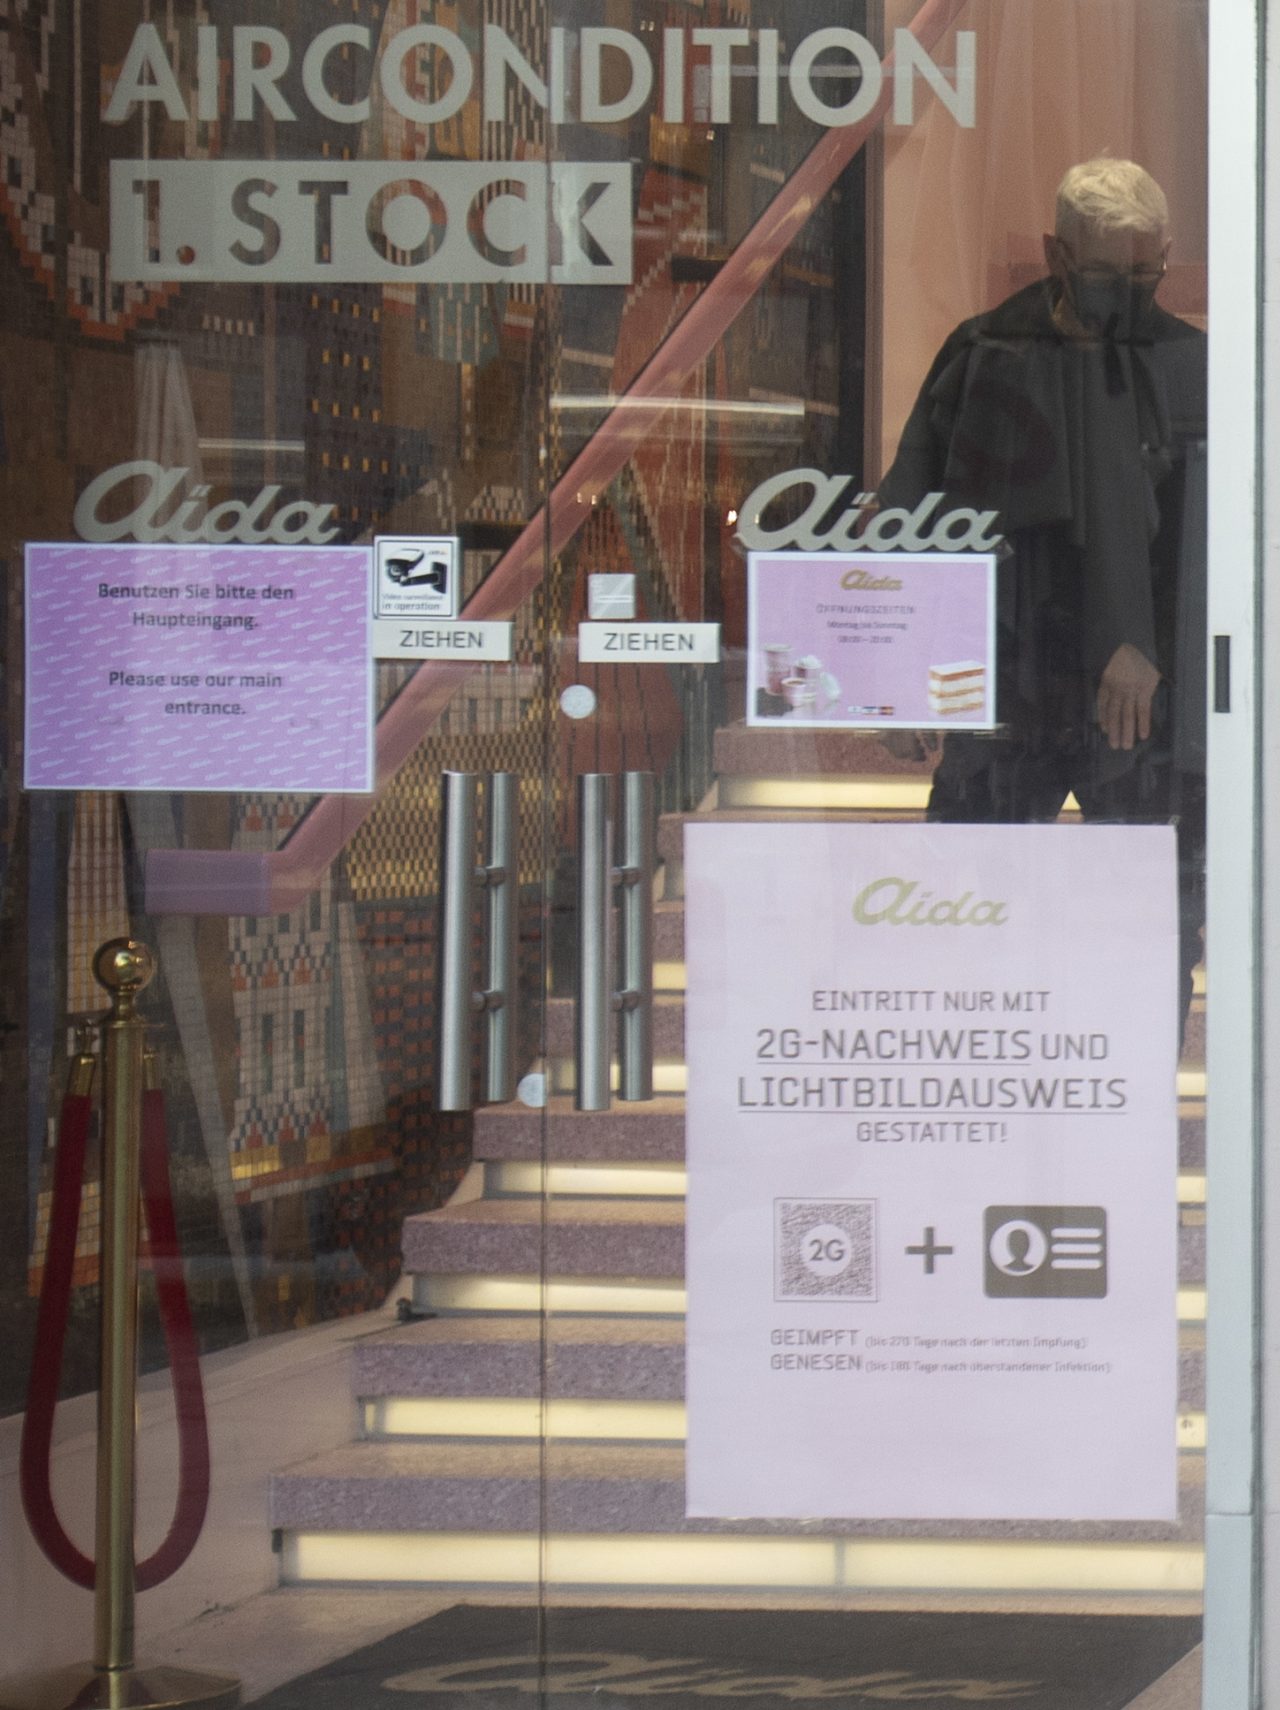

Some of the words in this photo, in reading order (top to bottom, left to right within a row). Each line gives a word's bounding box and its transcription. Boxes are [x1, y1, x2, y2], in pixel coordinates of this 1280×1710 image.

[102, 23, 977, 128] AIRCONDITION
[131, 179, 196, 268] 1.
[228, 177, 616, 268] STOCK
[98, 583, 180, 599] Benutzen
[184, 584, 210, 599] Sie
[215, 584, 257, 600] bitte
[261, 585, 294, 600] den
[132, 611, 259, 631] Haupteingang.
[399, 629, 485, 649] ZIEHEN
[603, 631, 695, 652] ZIEHEN
[108, 671, 165, 687] Please
[170, 674, 200, 687] use
[204, 674, 235, 687] our
[239, 671, 283, 688] main
[164, 702, 247, 716] entrance.
[812, 989, 937, 1013] EINTRITT
[943, 990, 996, 1013] NUR
[1002, 990, 1051, 1013] MIT
[756, 1027, 1032, 1061] 2G-NACHWEIS
[1040, 1033, 1110, 1061] UND
[737, 1076, 1128, 1109] LICHTBILDAUSWEIS
[856, 1120, 1008, 1143] GESTATTET!
[807, 1238, 845, 1263] 2G
[770, 1328, 861, 1347] GEIMPFT
[770, 1353, 862, 1372] GENESEN
